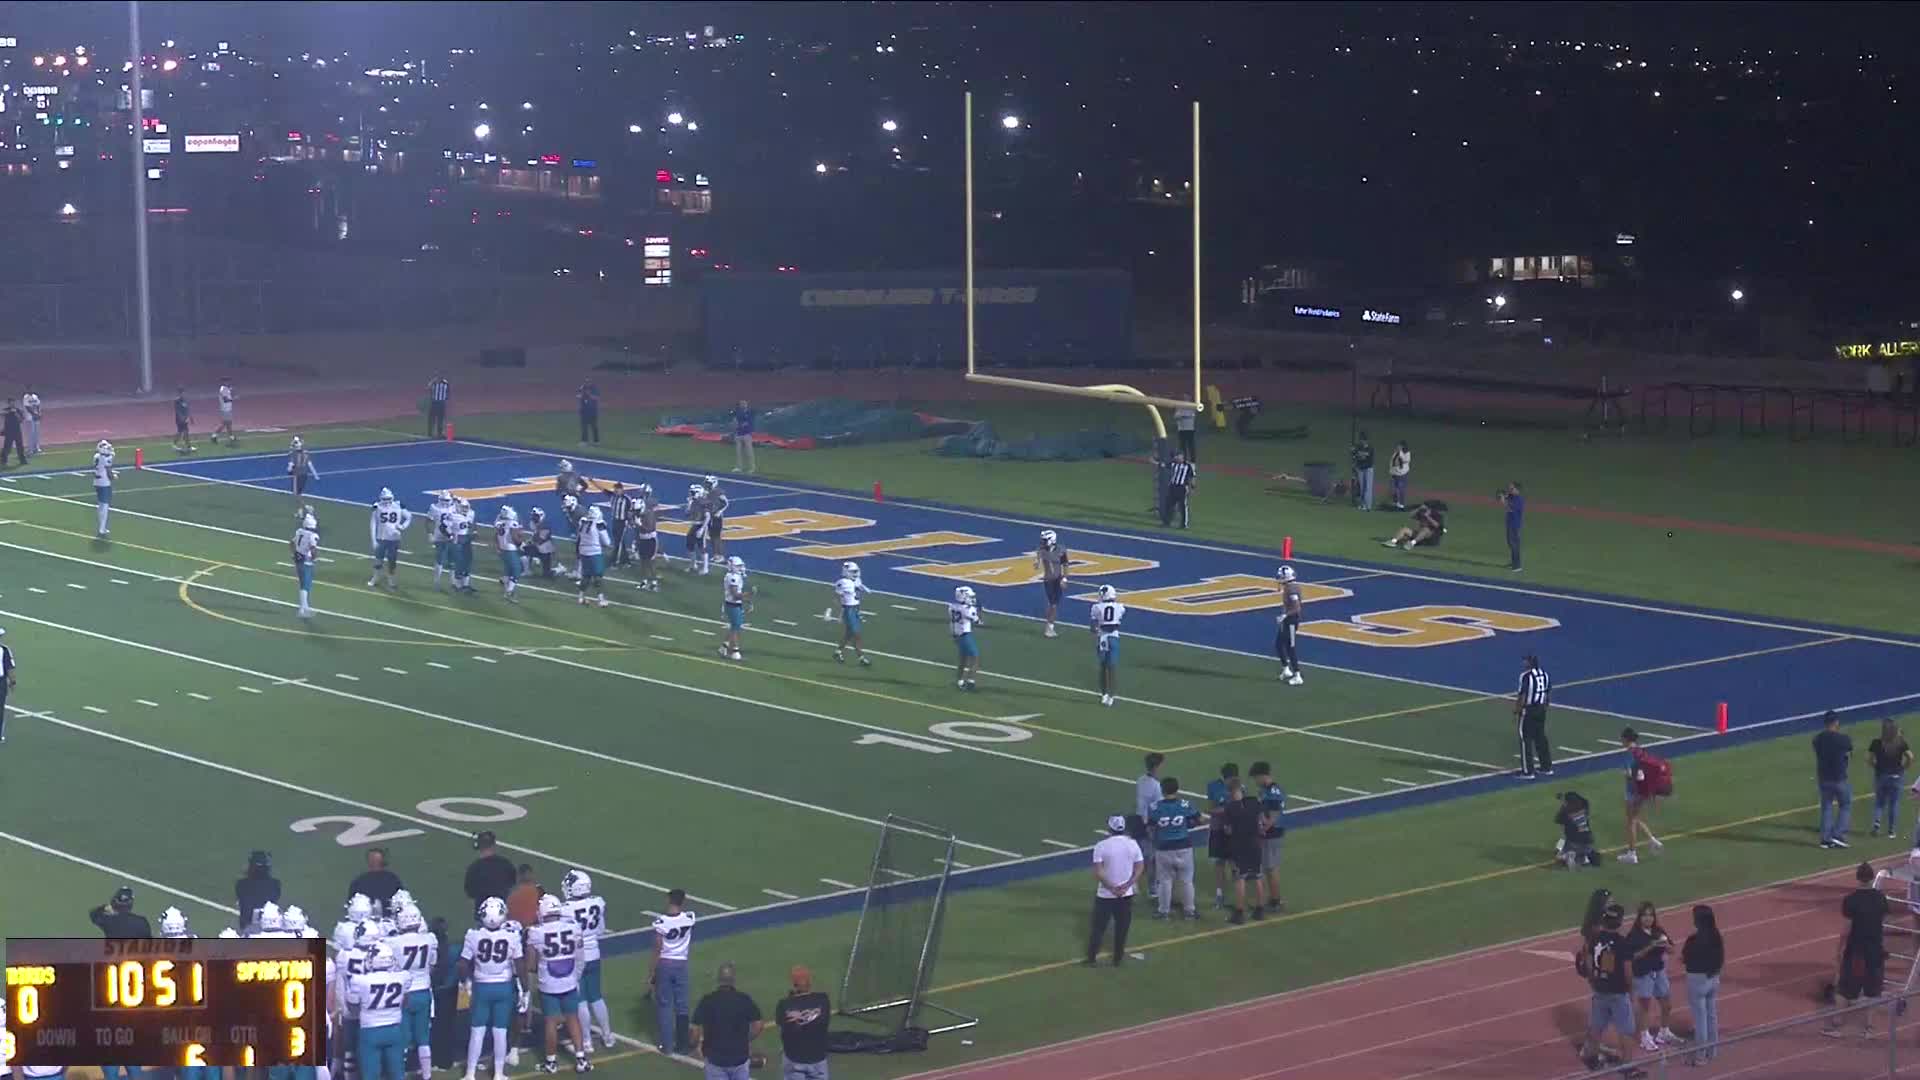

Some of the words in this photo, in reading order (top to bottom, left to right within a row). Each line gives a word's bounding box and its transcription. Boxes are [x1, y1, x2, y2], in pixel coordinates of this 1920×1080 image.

[1103, 606, 1114, 622] 0
[853, 721, 1032, 754] 10
[290, 796, 528, 847] 20
[575, 904, 600, 931] 53
[403, 944, 429, 970] 71
[476, 938, 509, 964] 99
[543, 930, 576, 958] 55
[367, 981, 403, 1010] 72
